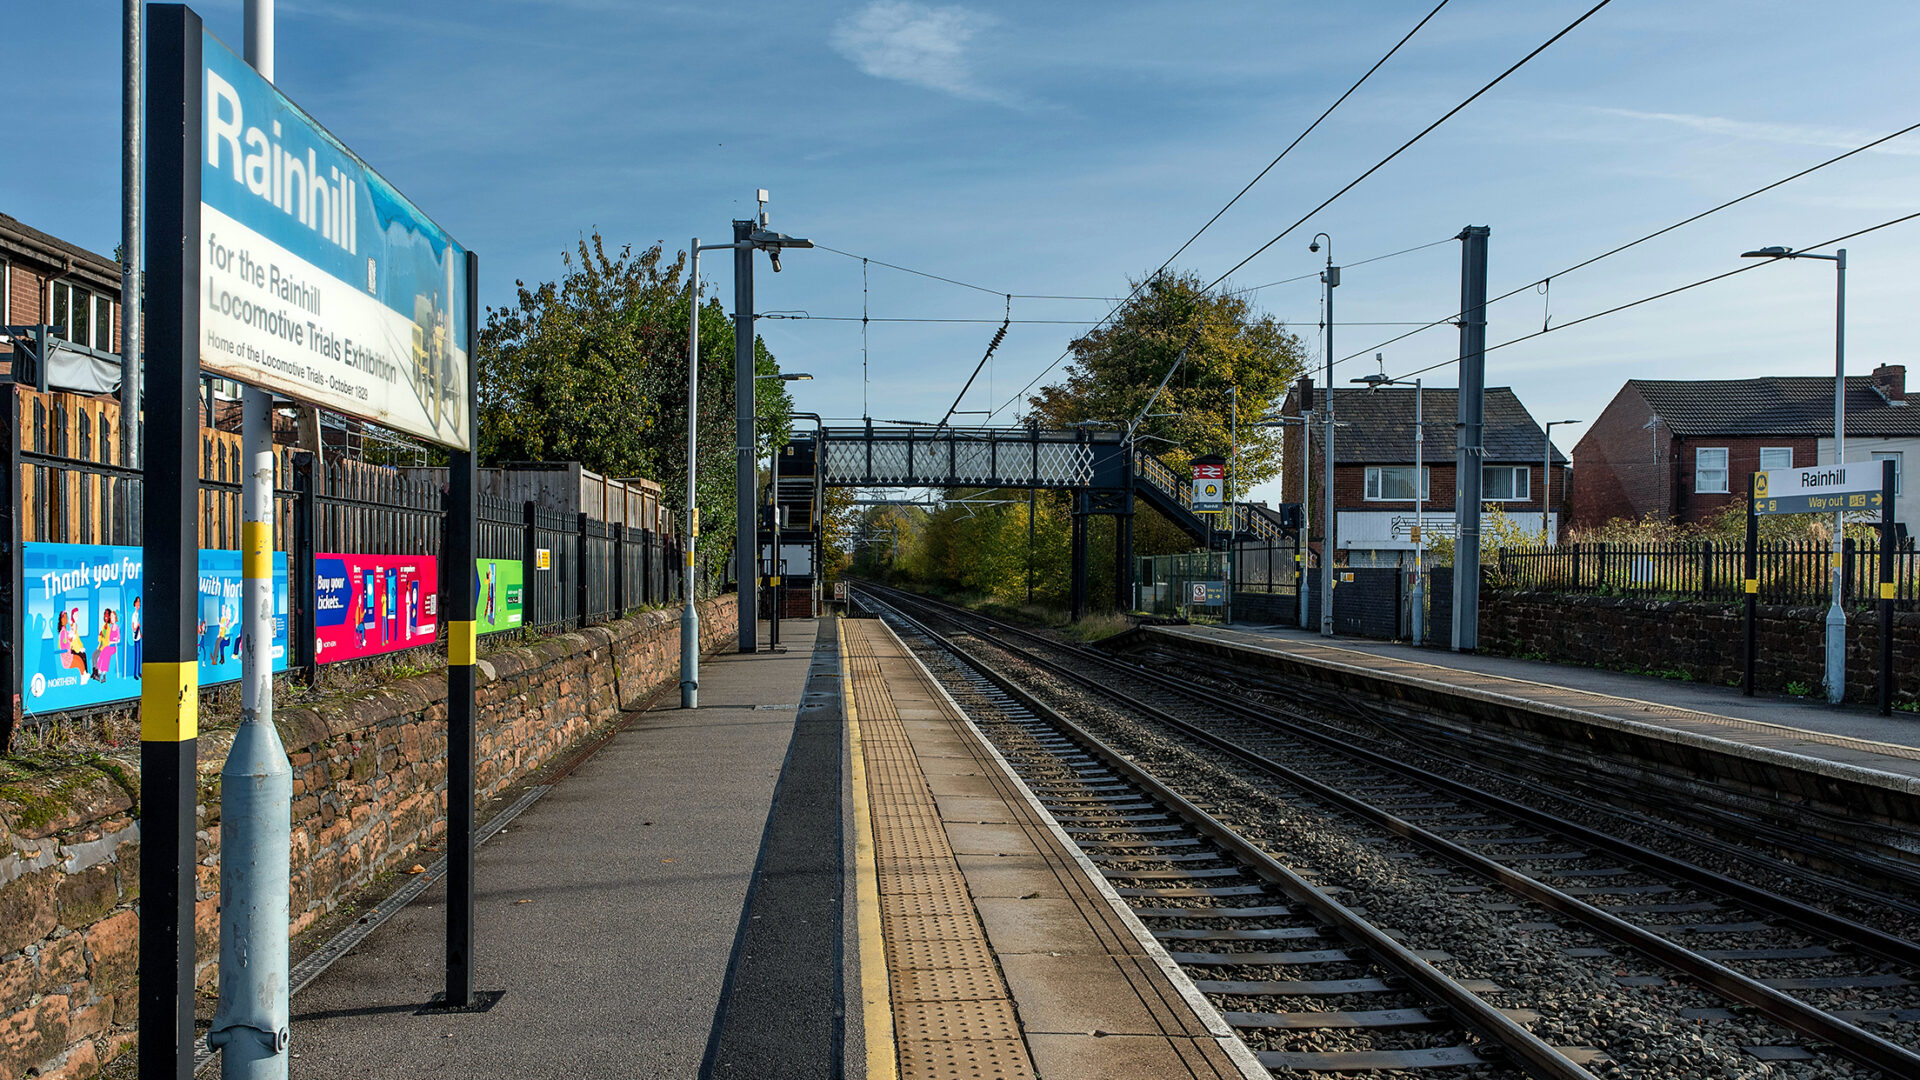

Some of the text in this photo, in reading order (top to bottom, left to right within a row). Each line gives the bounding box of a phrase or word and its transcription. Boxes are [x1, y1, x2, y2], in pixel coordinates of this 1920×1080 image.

[207, 67, 357, 256] Rainhill
[208, 232, 321, 316] for the Rainhill
[209, 275, 397, 385] Locomotive Trials Exhibition
[207, 329, 235, 354] Home
[236, 341, 246, 359] of
[246, 344, 260, 363] the
[261, 350, 305, 379] Locomotive
[306, 366, 324, 386] Trials
[329, 375, 355, 396] October
[355, 386, 369, 401] 1829
[1801, 468, 1846, 488] Rainhill
[1808, 496, 1843, 509] Way out
[42, 556, 142, 600] Thank you for
[199, 574, 222, 597] with
[317, 575, 345, 593] Buy your
[47, 676, 77, 688] NORTHERN
